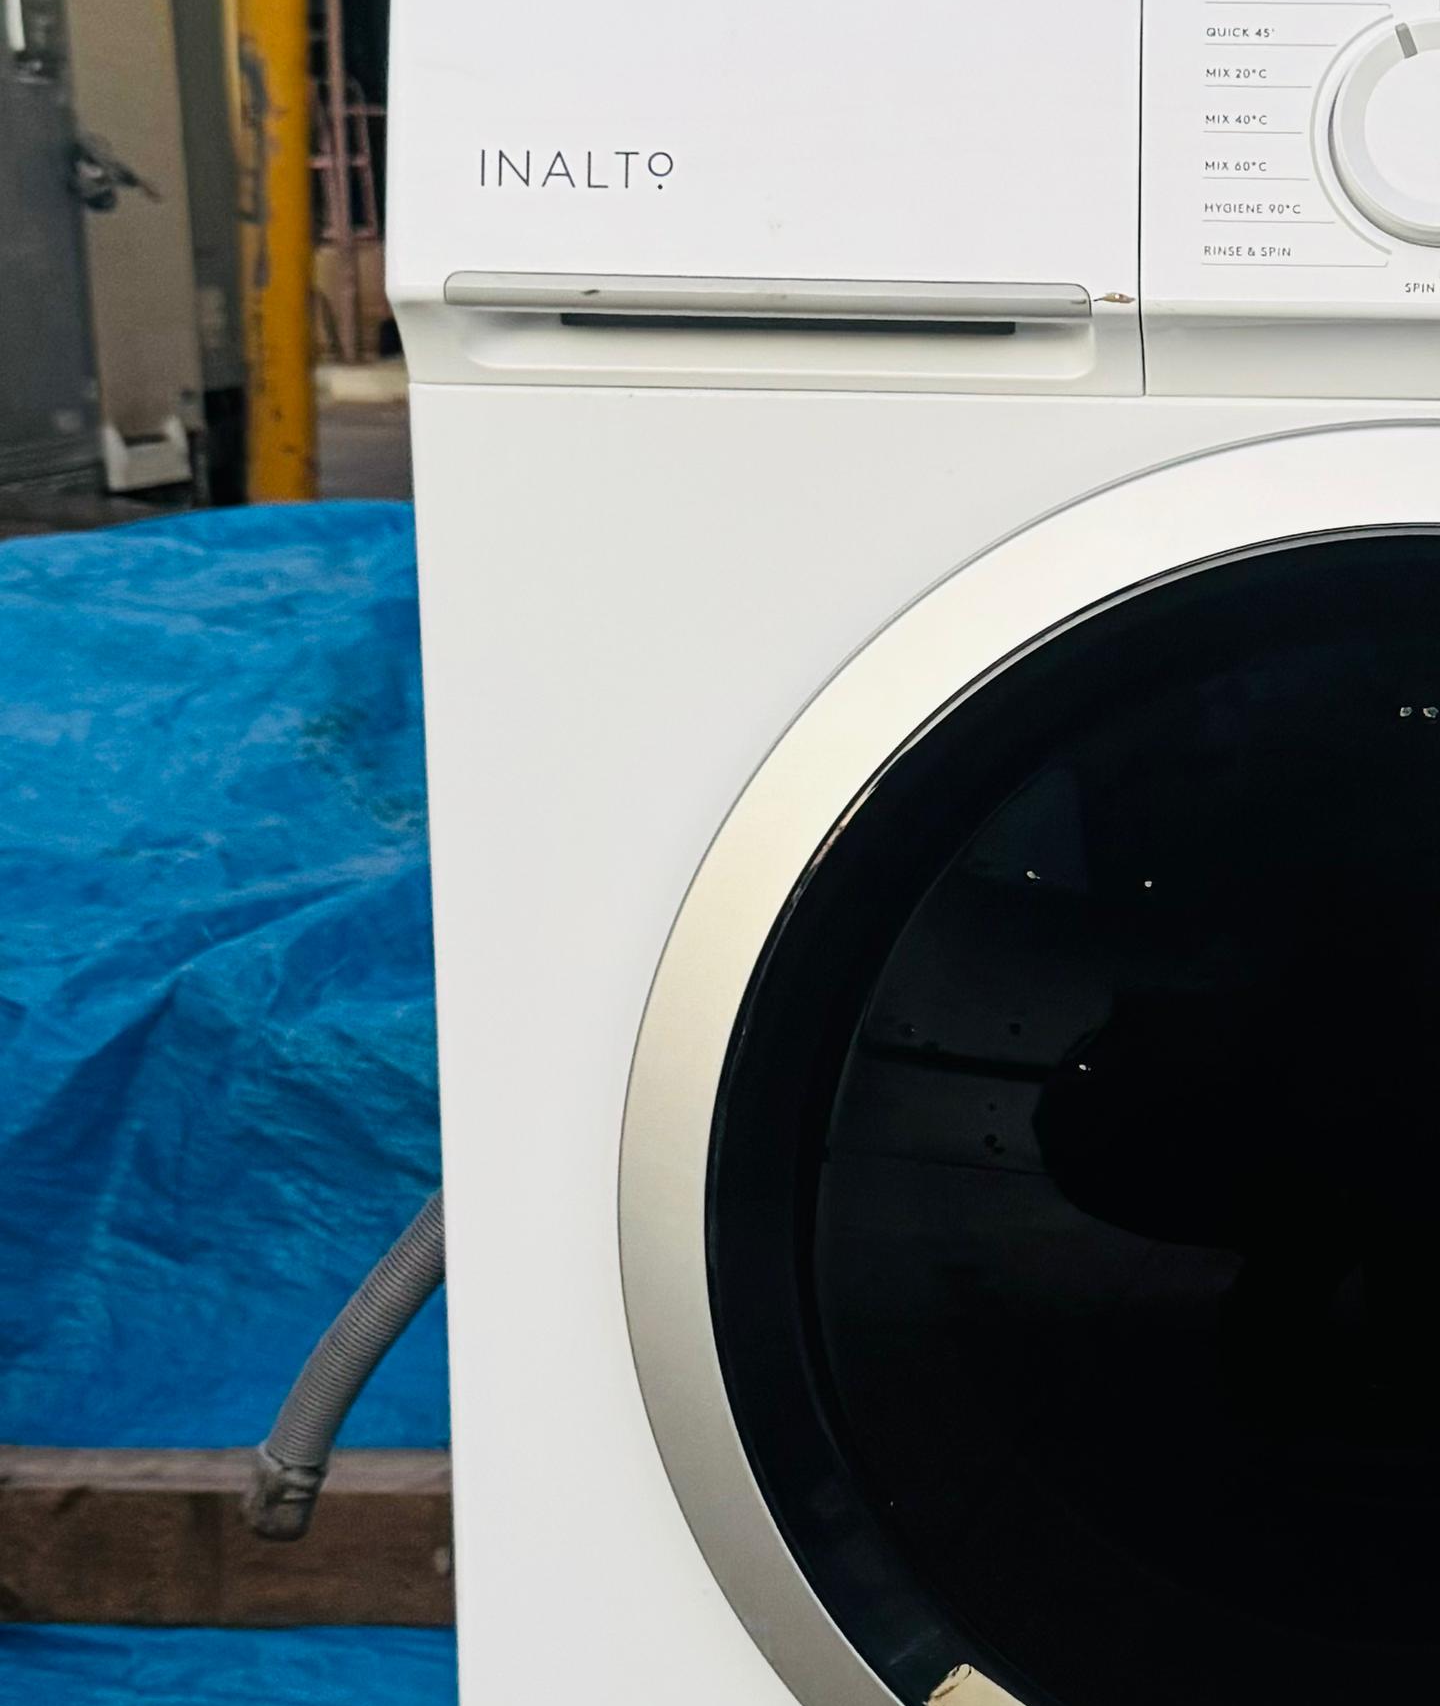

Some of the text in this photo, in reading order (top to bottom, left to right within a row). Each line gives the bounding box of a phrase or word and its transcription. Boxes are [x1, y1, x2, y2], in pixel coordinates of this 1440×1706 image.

[1206, 27, 1249, 39] QUICK
[1205, 68, 1267, 79] MIX 20°C
[1205, 114, 1268, 125] MIX 40°C
[481, 149, 674, 190] INALTO
[1204, 161, 1267, 172] MIX 60°C
[1204, 203, 1301, 215] HYGIENE 90°C
[1203, 246, 1292, 257] RINSE & SPIN
[1404, 282, 1436, 293] SPIN
